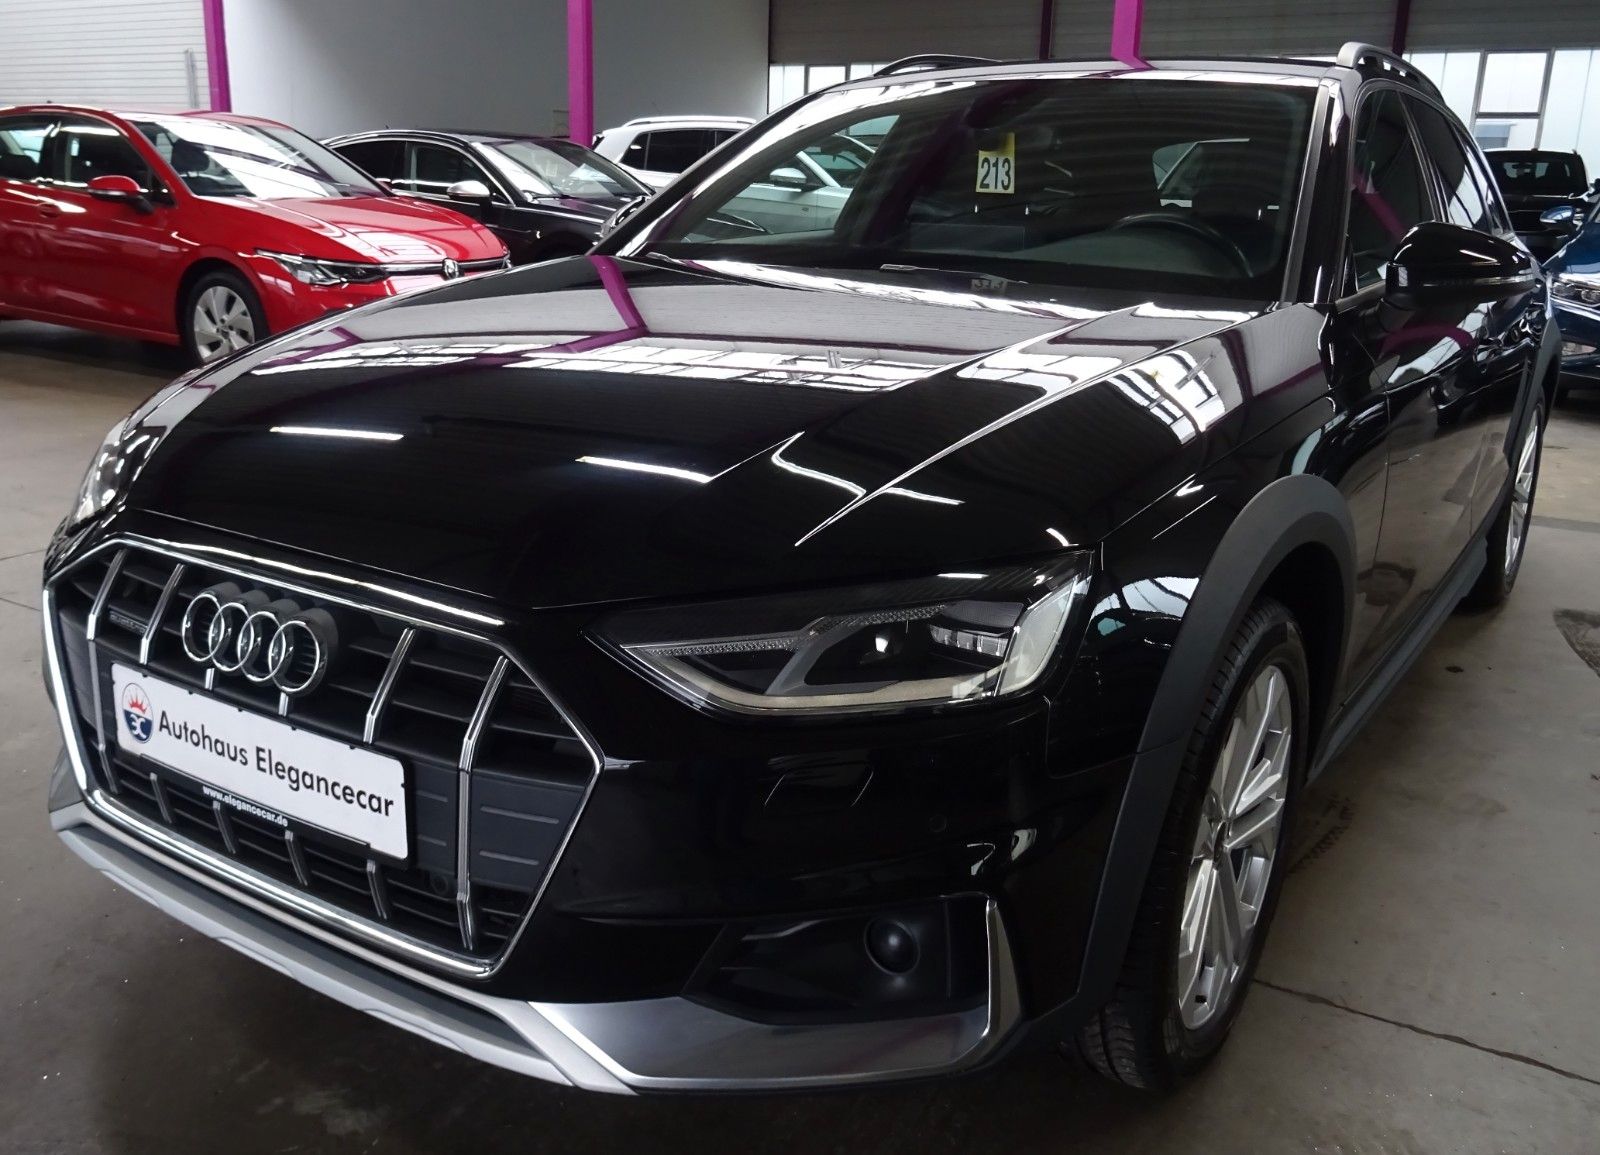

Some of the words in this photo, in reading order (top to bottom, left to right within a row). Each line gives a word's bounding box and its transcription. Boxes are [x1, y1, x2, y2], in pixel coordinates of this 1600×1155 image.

[979, 157, 1011, 190] 213
[158, 710, 249, 767] Autohaus
[255, 745, 394, 817] Elegancecar
[202, 785, 289, 828] www.elegancecar.de
